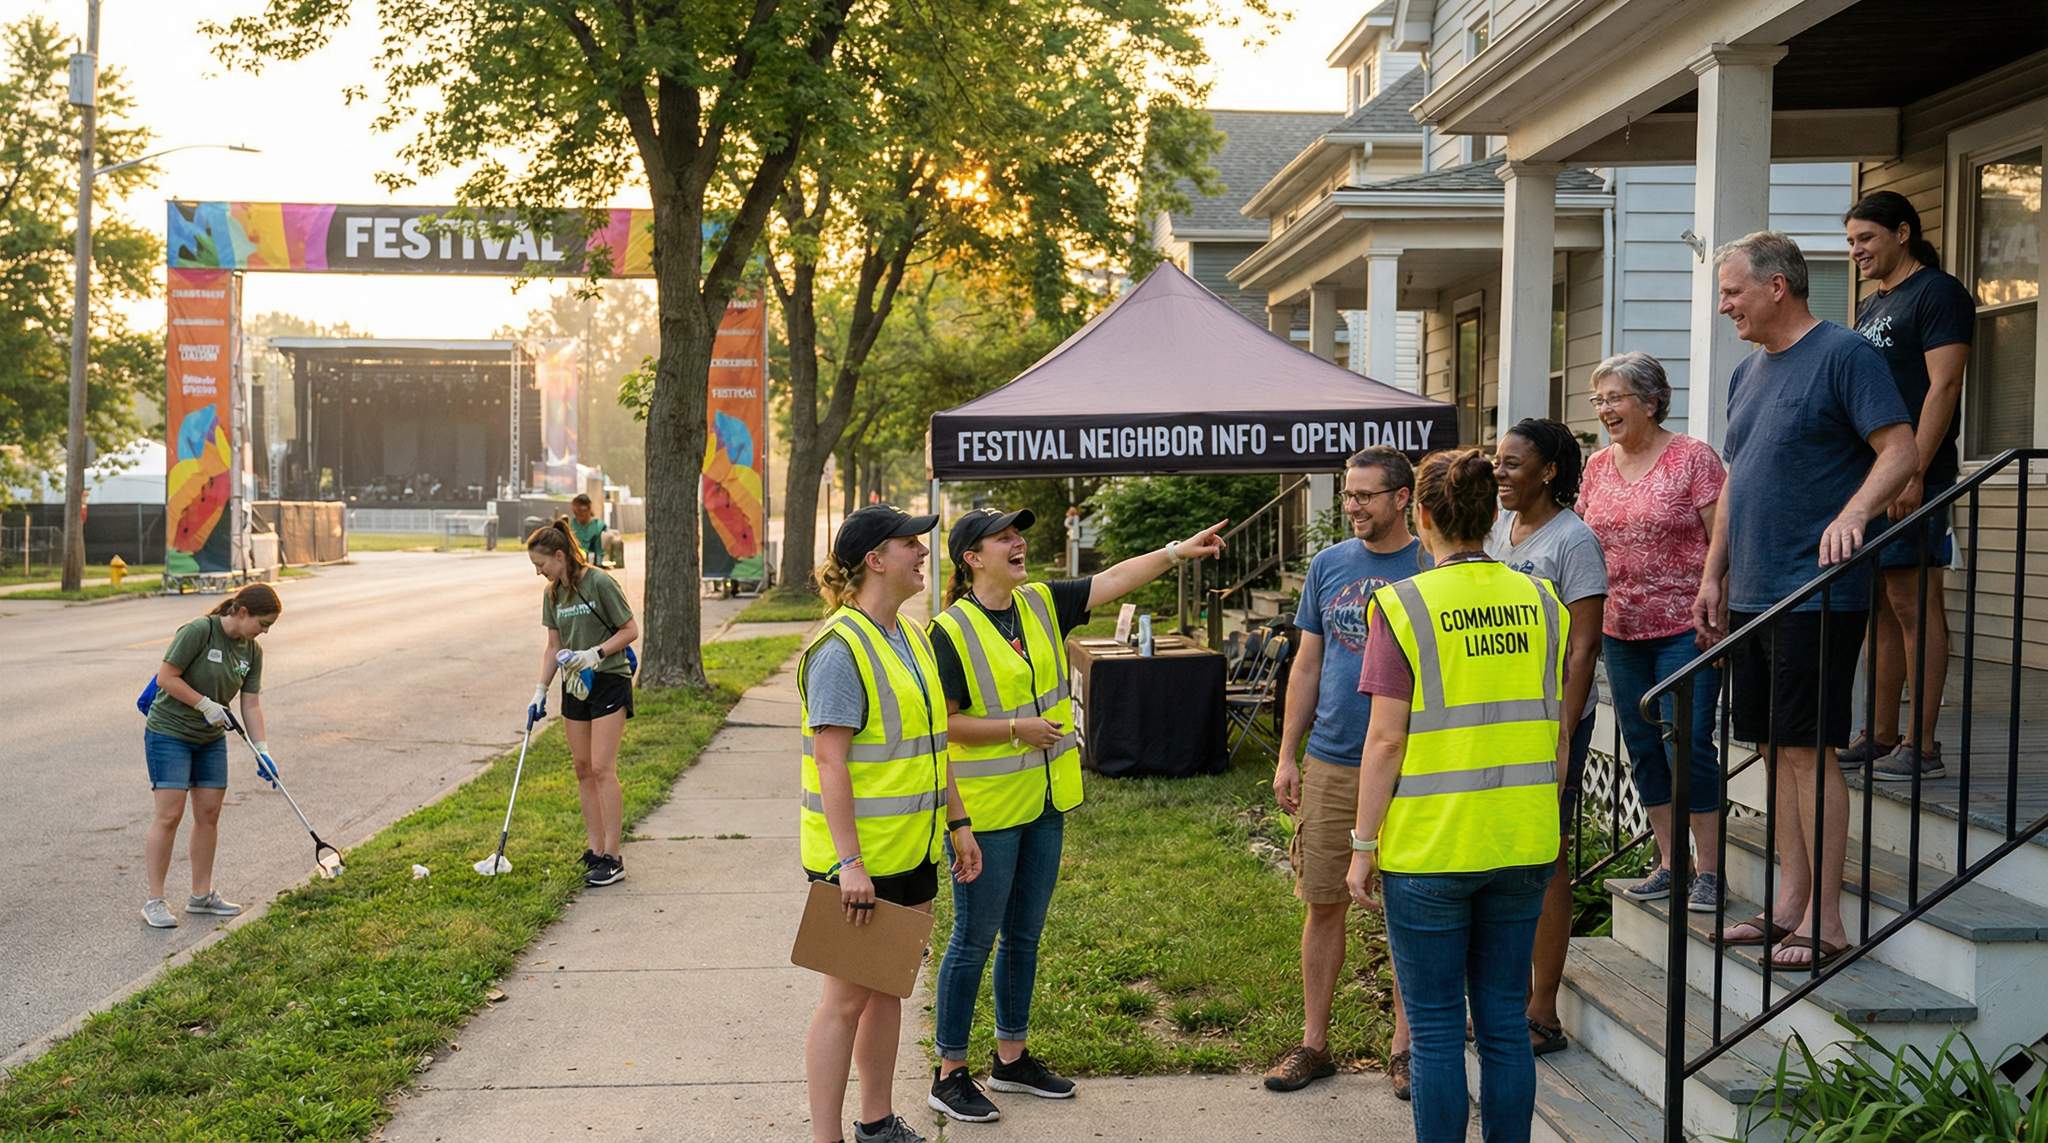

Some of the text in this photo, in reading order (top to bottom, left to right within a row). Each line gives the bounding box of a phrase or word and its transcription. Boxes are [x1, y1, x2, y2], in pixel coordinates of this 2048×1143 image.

[346, 217, 565, 261] FESTIVAL
[958, 429, 1073, 462] FESTIVAL
[1080, 425, 1204, 459] NEIGHBOR
[1211, 423, 1267, 455] INFO
[1291, 421, 1356, 454] OPEN
[1363, 420, 1434, 451] DAILY
[1440, 604, 1539, 632] COMMUNITY
[1465, 632, 1529, 657] LIAISON
